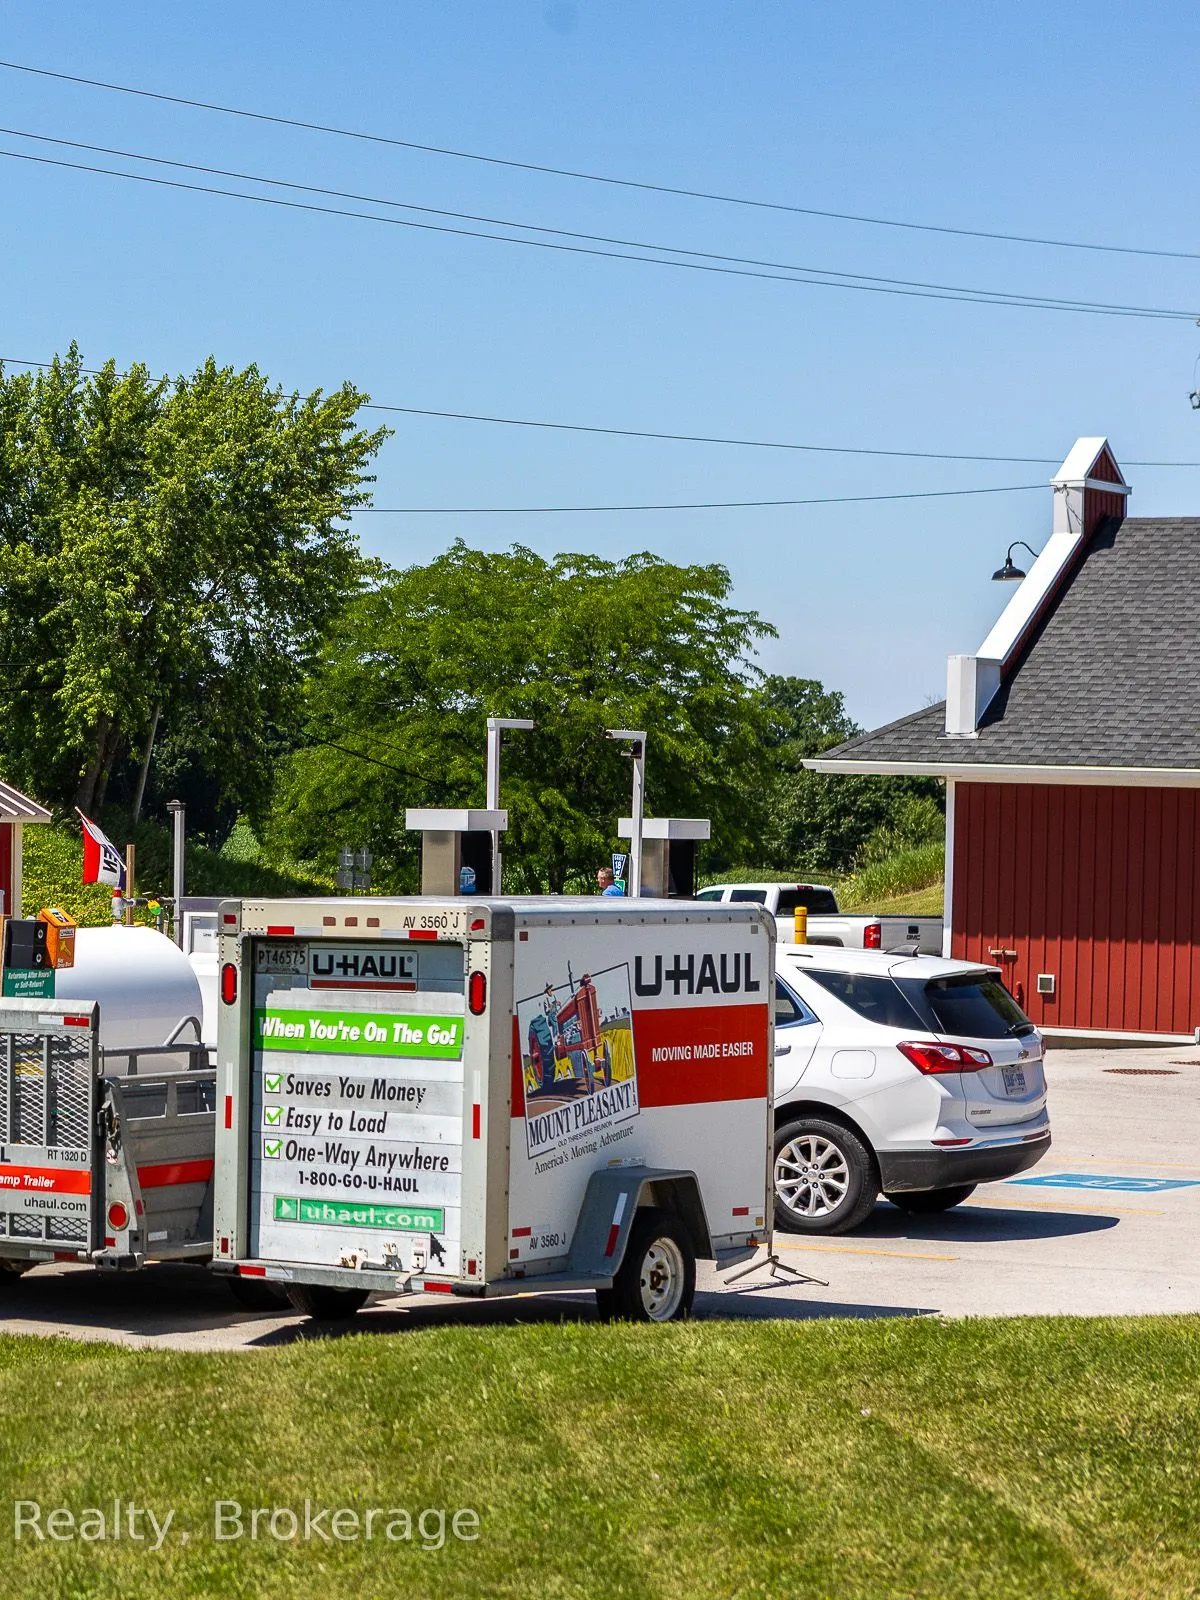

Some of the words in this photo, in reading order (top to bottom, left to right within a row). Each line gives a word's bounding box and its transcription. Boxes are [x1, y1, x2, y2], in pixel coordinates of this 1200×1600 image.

[403, 916, 416, 928] AV
[420, 916, 448, 929] 3560
[452, 917, 459, 928] J
[258, 950, 306, 965] PT46575
[313, 954, 413, 978] U-HAUL
[8, 972, 27, 980] Returning
[28, 971, 38, 979] After
[634, 952, 760, 997] U-HAUL
[260, 1017, 304, 1038] When
[309, 1019, 360, 1041] You're
[364, 1022, 387, 1043] On
[392, 1023, 423, 1045] The
[427, 1024, 458, 1046] Go!
[652, 1045, 691, 1062] MOVING
[693, 1043, 721, 1059] MADE
[722, 1042, 754, 1057] EASIER
[286, 1073, 331, 1097] Saves
[339, 1077, 365, 1099] You
[371, 1079, 426, 1108] Money
[286, 1107, 322, 1135] Easy
[328, 1112, 343, 1130] to
[349, 1111, 387, 1133] Load
[528, 1106, 572, 1148] MOUNT
[574, 1083, 631, 1129] PLEASANT
[47, 1150, 58, 1160] RT
[60, 1151, 79, 1161] 1320
[81, 1152, 87, 1162] D
[285, 1140, 360, 1171] One-Way
[365, 1145, 449, 1173] Anywhere
[534, 1151, 568, 1175] America's
[571, 1141, 597, 1160] Moving
[599, 1127, 634, 1148] Adventure
[23, 1175, 55, 1188] Trailer
[298, 1171, 419, 1193] 1-800-GO-U-HAUL
[24, 1197, 87, 1211] uhaul.com
[306, 1204, 434, 1228] uhaul.com
[529, 1237, 538, 1250] AV
[540, 1234, 559, 1248] 3560
[561, 1234, 566, 1245] J
